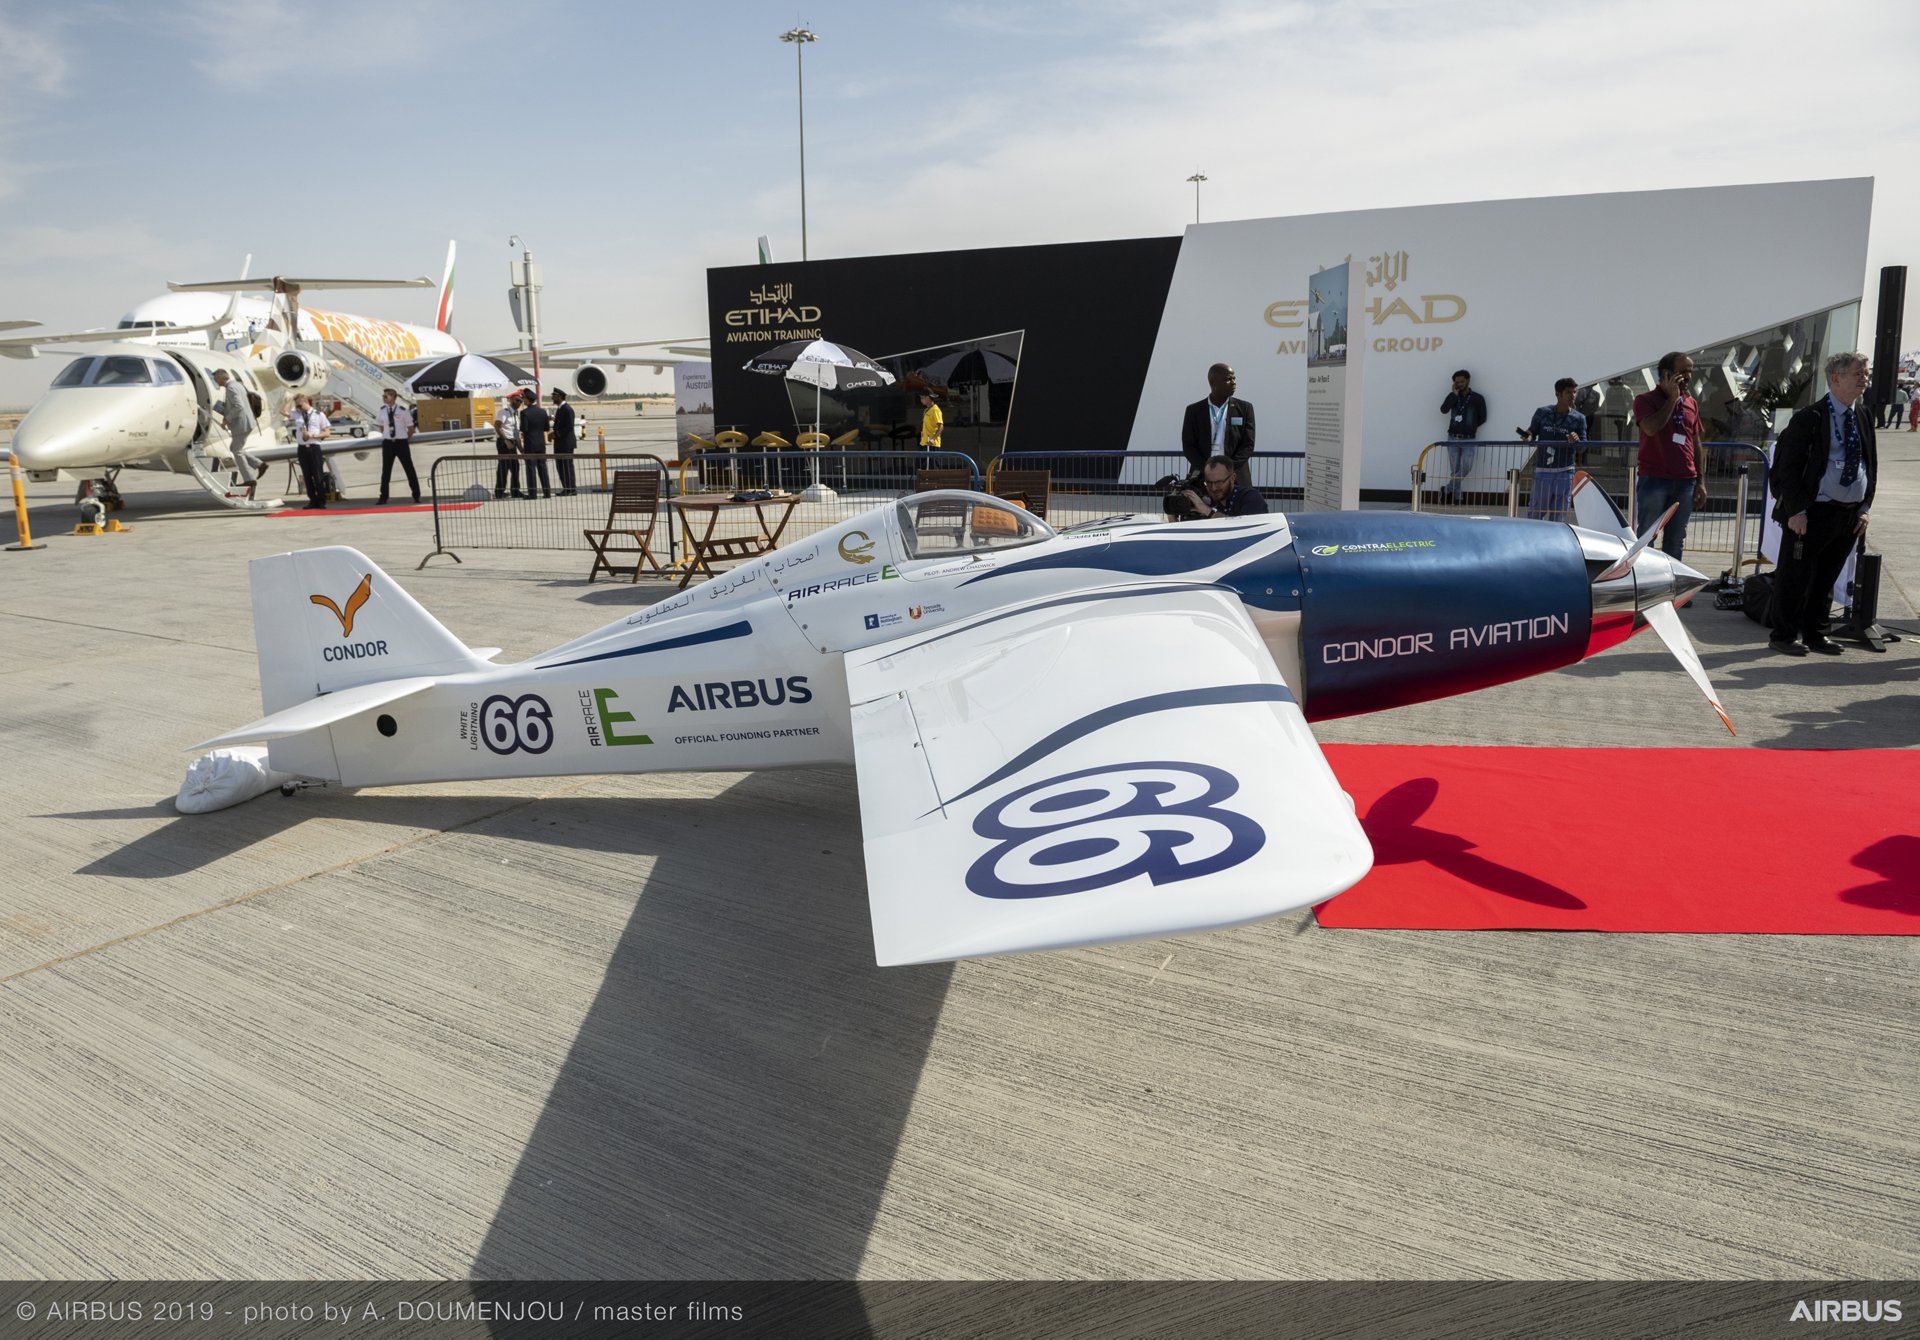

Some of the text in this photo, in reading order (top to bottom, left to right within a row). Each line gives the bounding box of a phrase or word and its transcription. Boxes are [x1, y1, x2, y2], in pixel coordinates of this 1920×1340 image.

[725, 306, 822, 327] ETIHAD
[1264, 295, 1467, 328] EHAD
[726, 328, 822, 343] AVIATION TRAINING
[1373, 337, 1443, 353] GROUP
[355, 358, 384, 380] dnata
[418, 384, 450, 392] ETIHAD
[788, 565, 900, 601] AIR RACE E
[323, 640, 388, 662] CONDOR
[1323, 612, 1569, 664] CONDOR AVIATION
[667, 676, 813, 713] AIRBUS
[460, 711, 468, 740] WHITE
[479, 693, 554, 755] 66
[593, 688, 655, 747] E
[674, 727, 820, 744] OFFICIAL FOUNDING PARTNER
[965, 761, 1266, 899] 66
